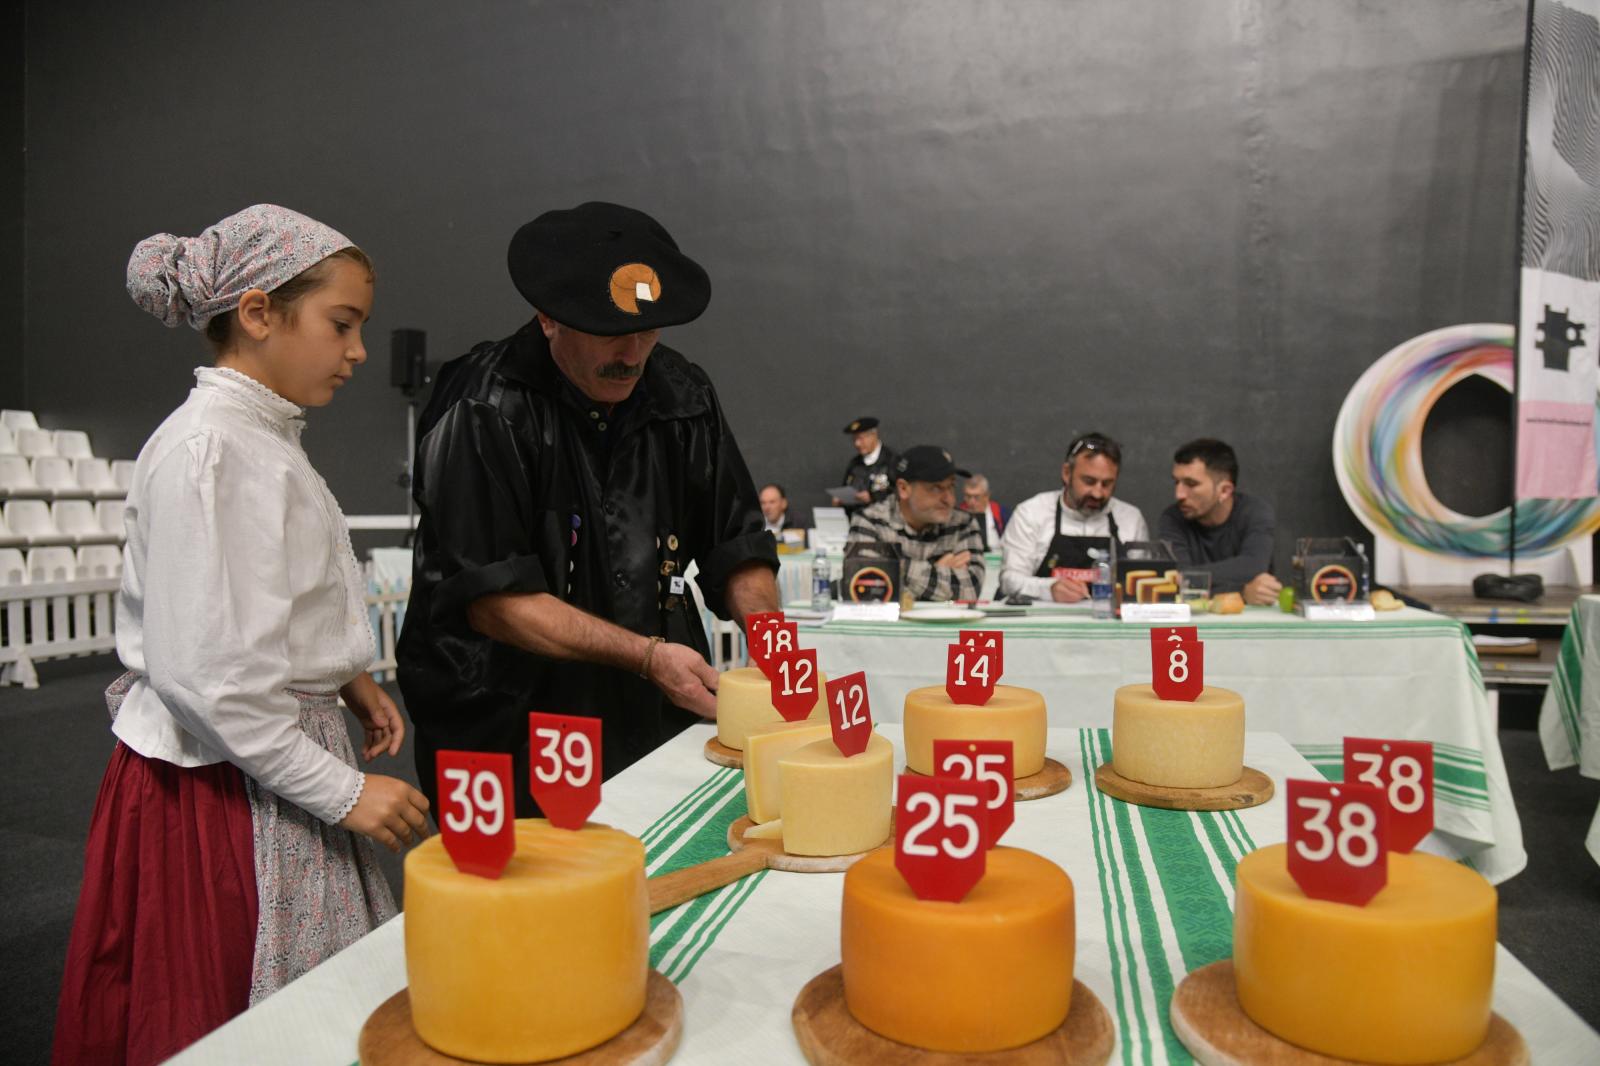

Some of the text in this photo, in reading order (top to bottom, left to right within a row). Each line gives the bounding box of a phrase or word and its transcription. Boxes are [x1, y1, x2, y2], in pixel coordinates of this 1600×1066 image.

[762, 629, 793, 659] 18
[1168, 649, 1189, 683] 8
[778, 659, 813, 696] 12
[954, 653, 989, 687] 14
[836, 684, 867, 730] 12
[535, 728, 593, 787] 39
[444, 768, 505, 836] 39
[902, 791, 979, 859] 25
[1295, 797, 1378, 867] 38
